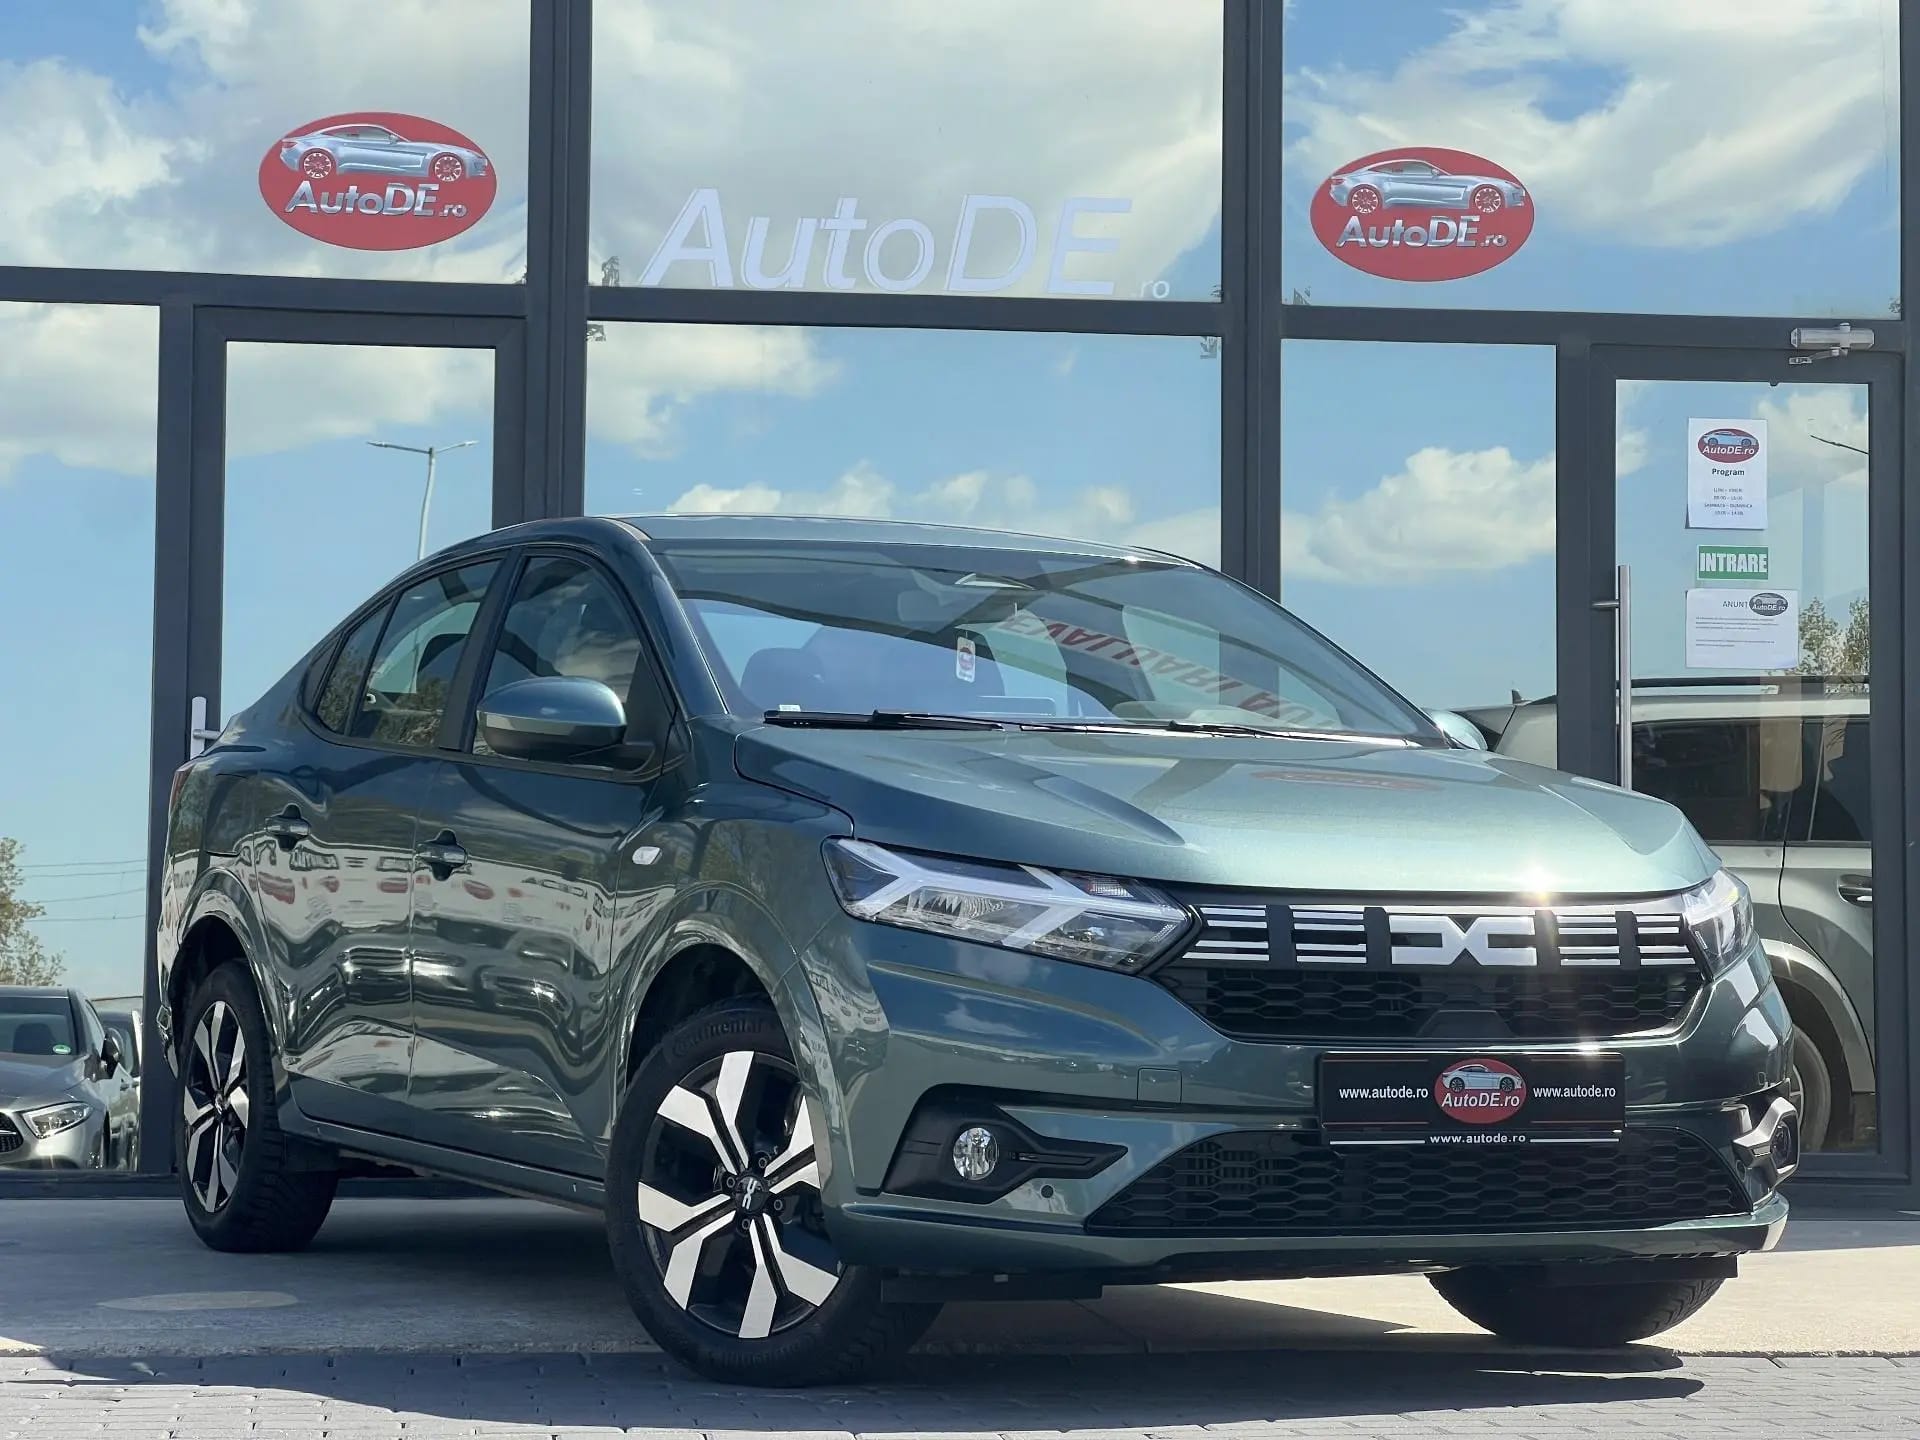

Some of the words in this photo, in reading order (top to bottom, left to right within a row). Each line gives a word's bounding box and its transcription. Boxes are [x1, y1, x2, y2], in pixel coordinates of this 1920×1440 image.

[1711, 468, 1745, 476] Program
[1700, 553, 1767, 572] INTRARE
[1339, 1084, 1429, 1099] www.autode.ro
[1533, 1084, 1616, 1098] www.autode.ro
[1441, 1092, 1520, 1107] AutoDE.ro
[1429, 1133, 1526, 1144] www.autode.ro
